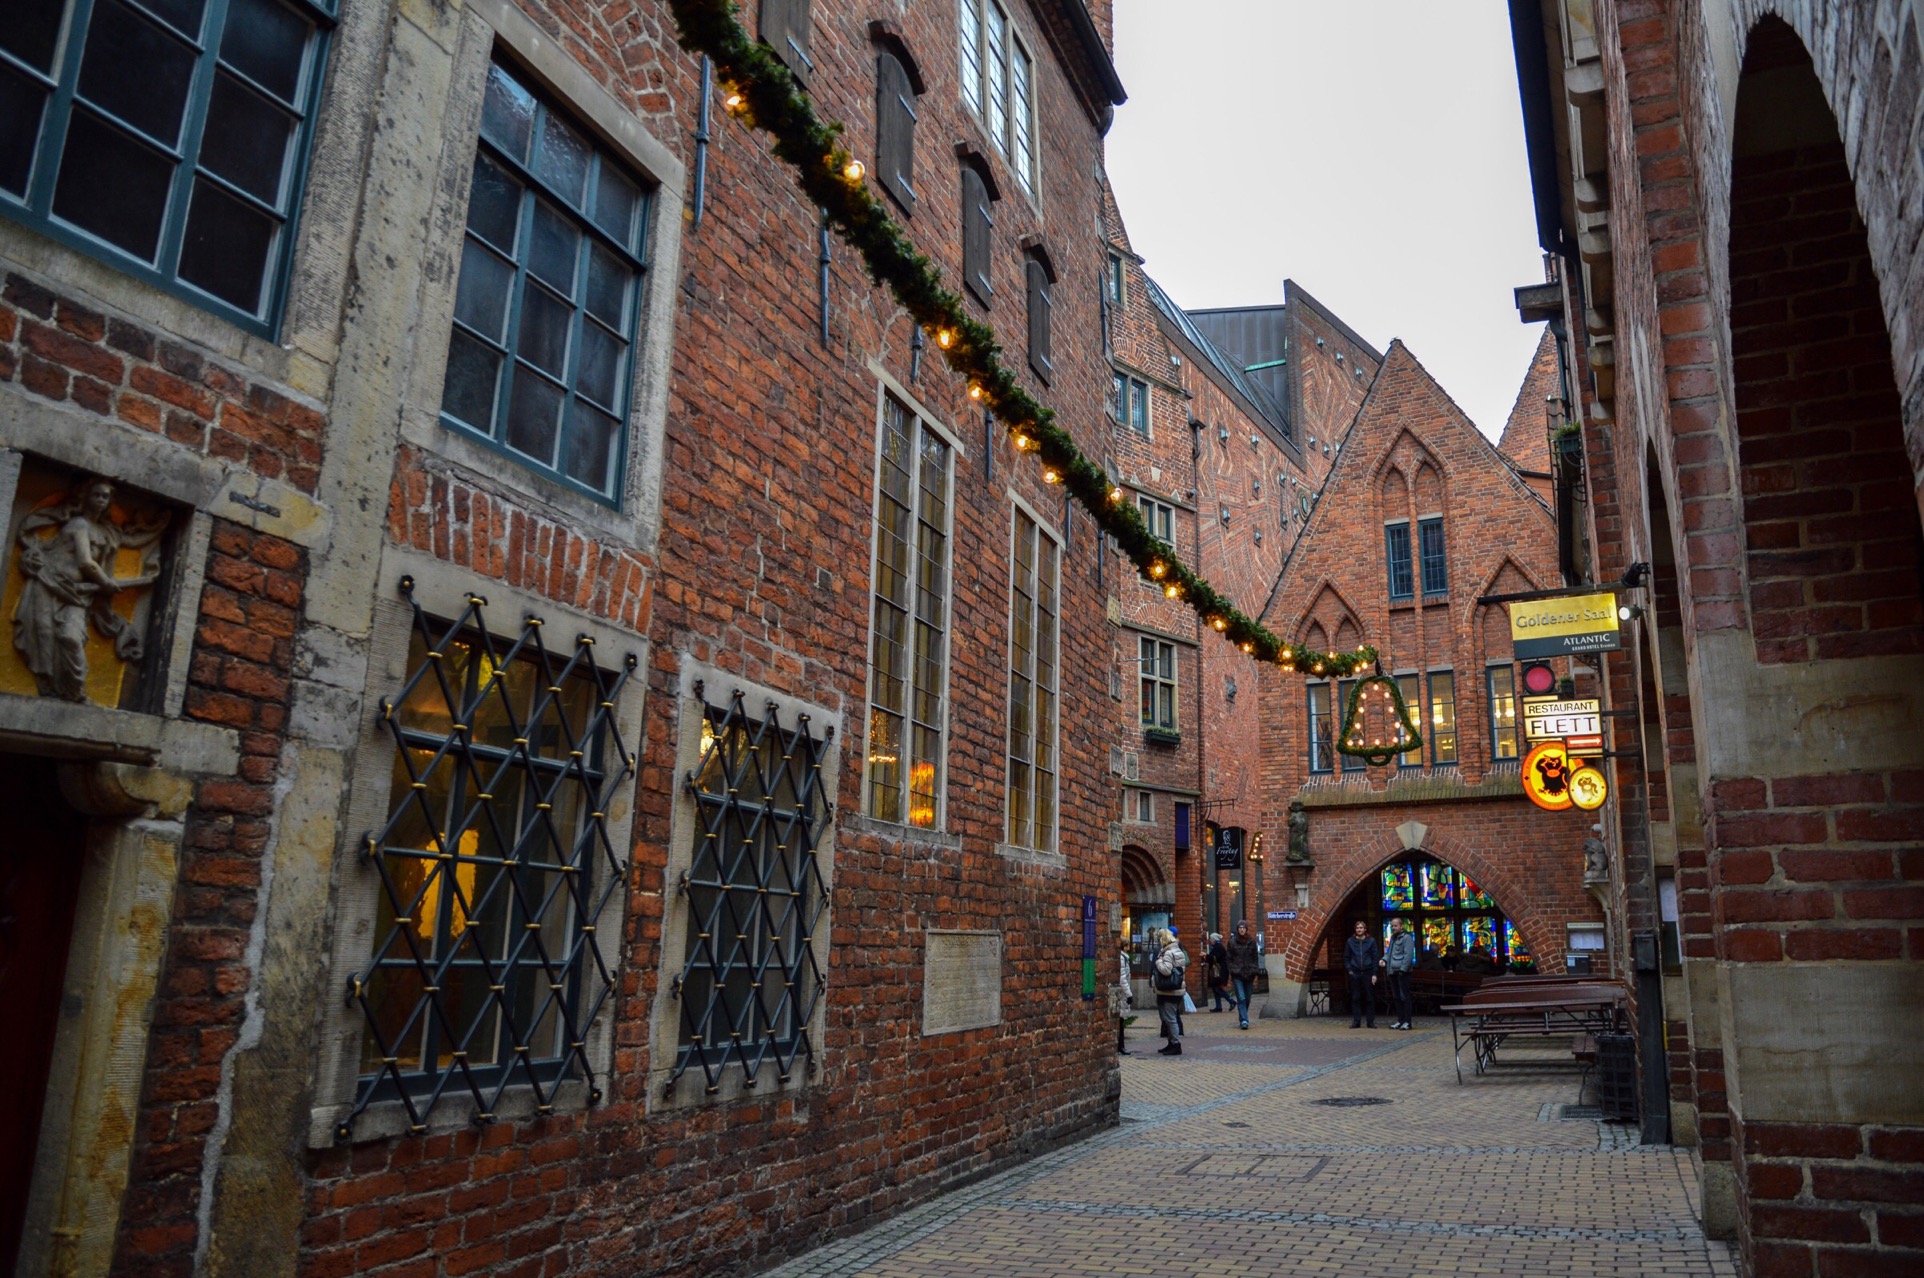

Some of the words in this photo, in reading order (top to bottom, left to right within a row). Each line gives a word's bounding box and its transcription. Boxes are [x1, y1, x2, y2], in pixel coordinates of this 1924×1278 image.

[1516, 612, 1579, 628] Goldener
[1584, 606, 1612, 621] Saal
[1563, 633, 1610, 646] ATLANTIC
[1528, 701, 1593, 714] RESTAURANT
[1531, 716, 1596, 735] FLETT
